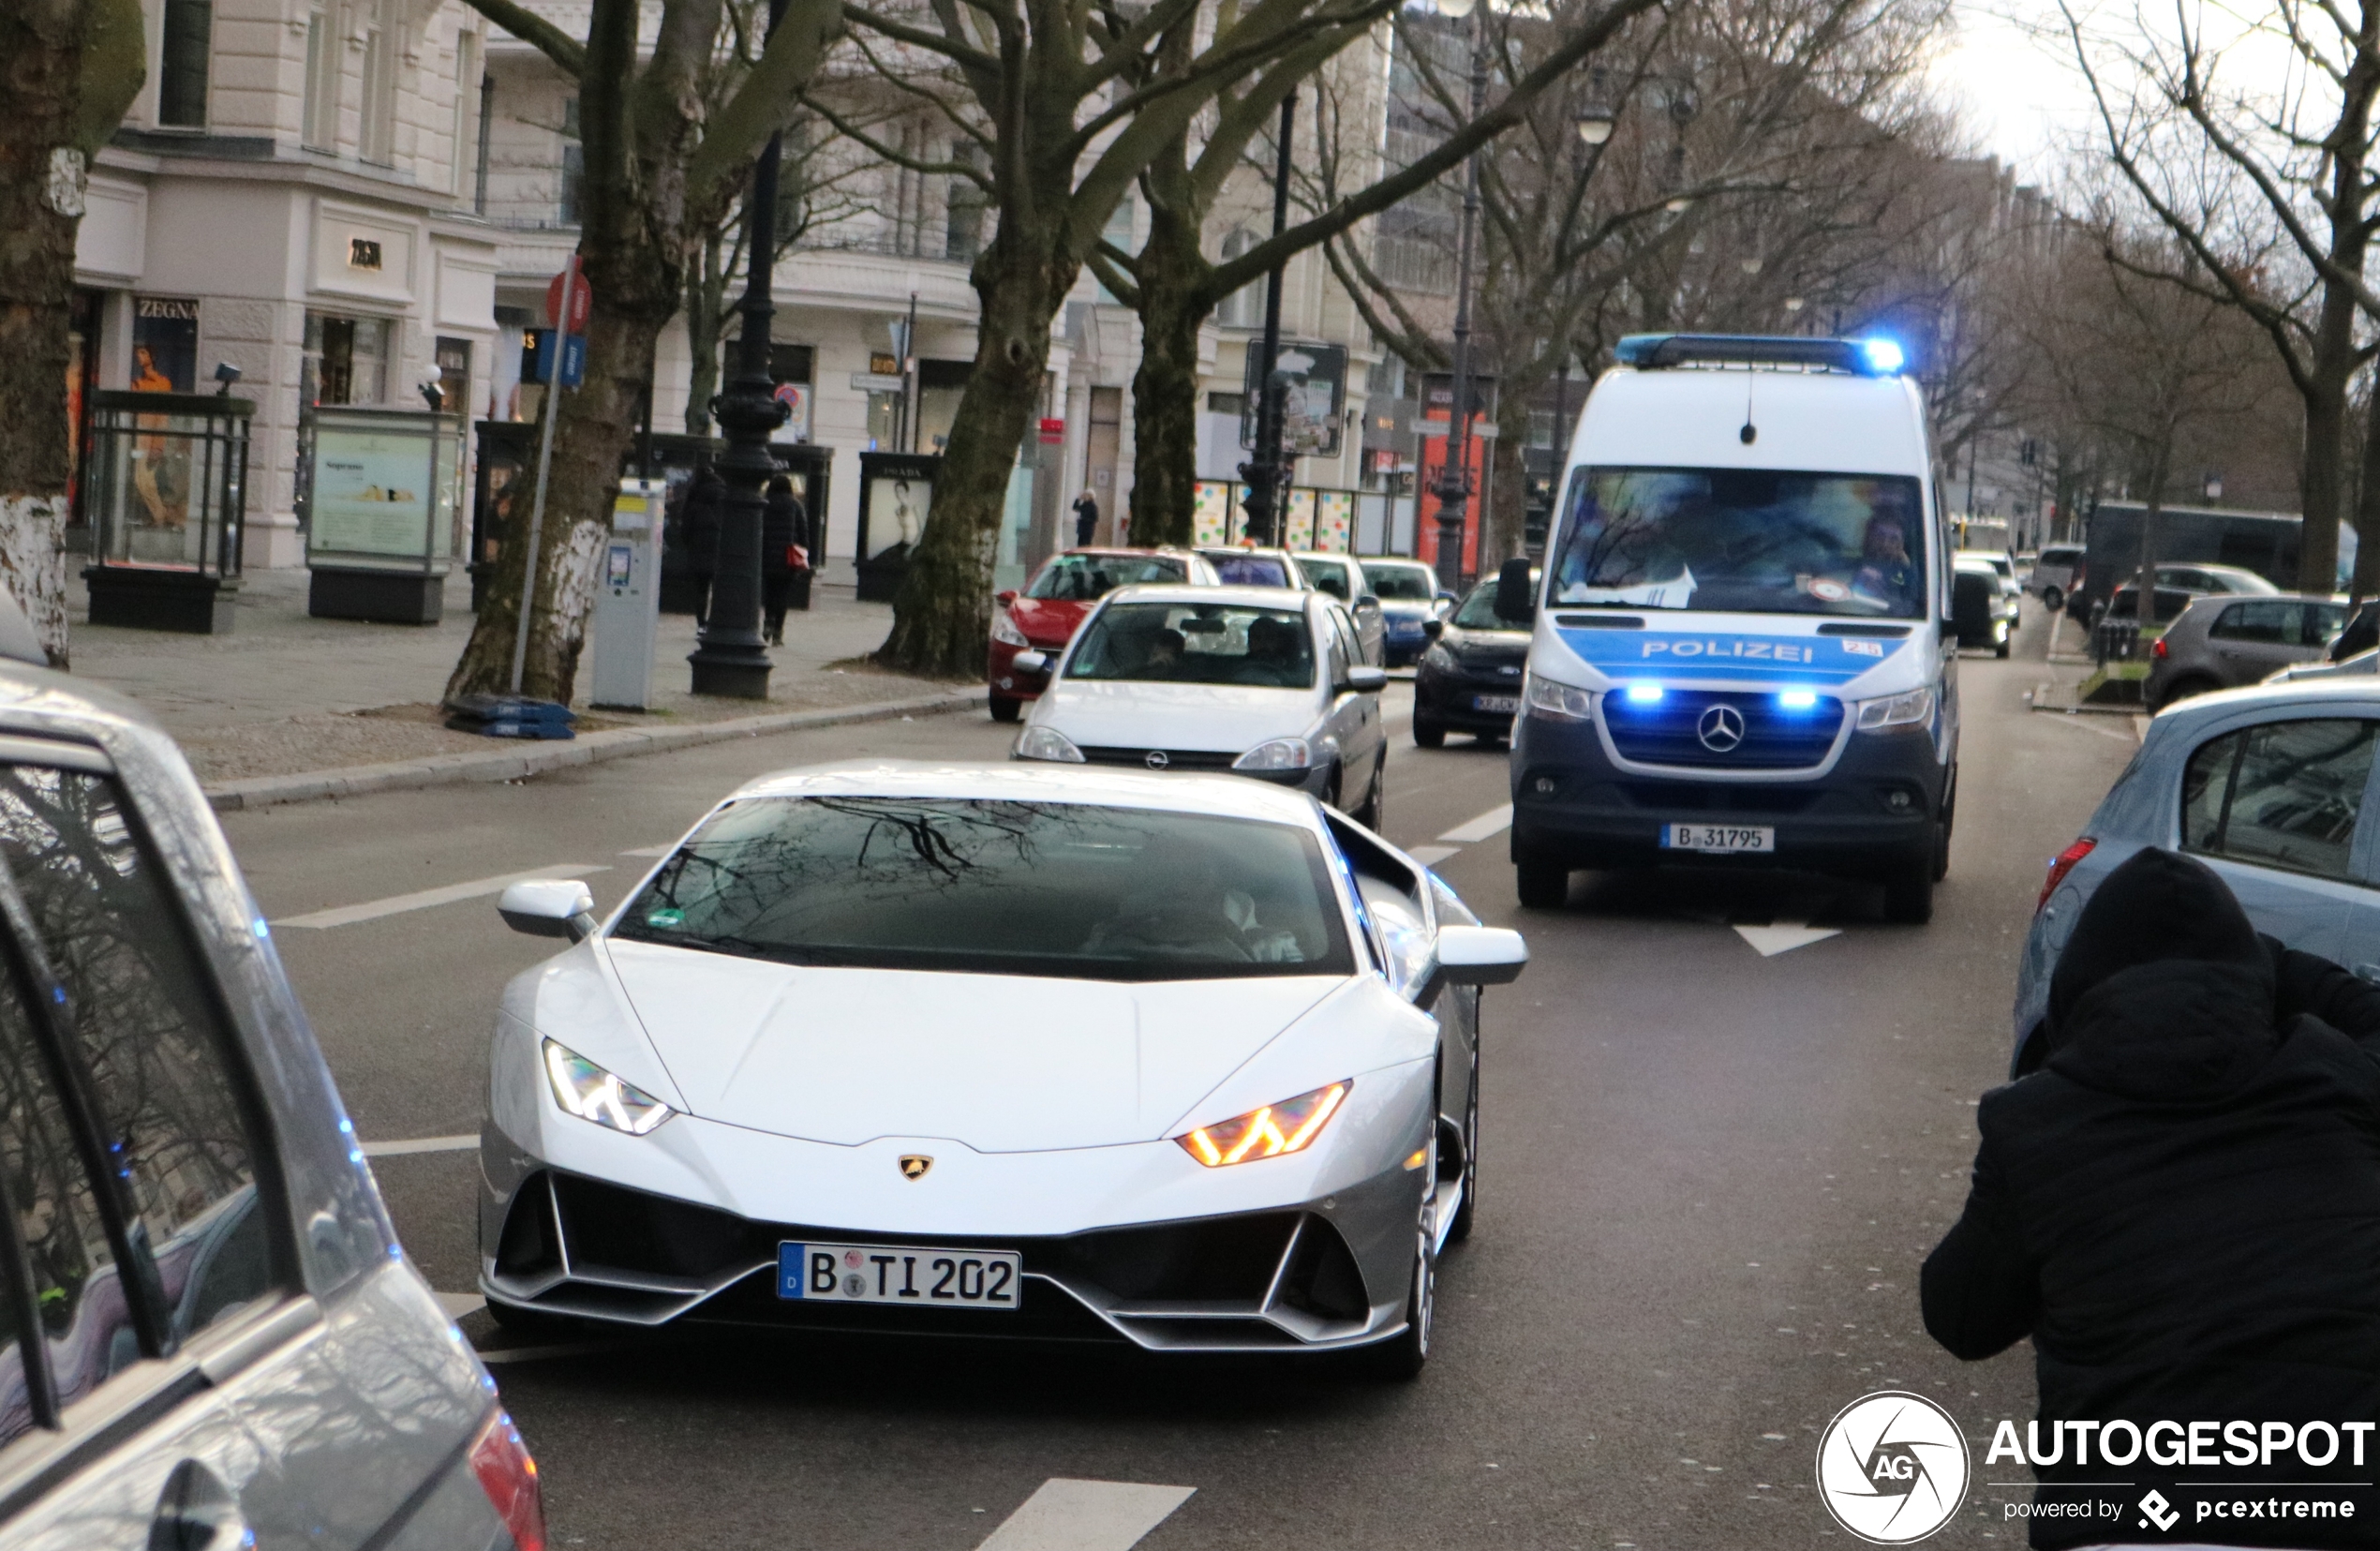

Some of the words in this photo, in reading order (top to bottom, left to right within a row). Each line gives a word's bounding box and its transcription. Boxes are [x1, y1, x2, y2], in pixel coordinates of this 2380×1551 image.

[140, 300, 199, 320] ZEGNA
[1642, 640, 1813, 664] POLIZEI
[1848, 642, 1879, 655] 25
[1679, 828, 1690, 845] B
[1703, 828, 1762, 847] 31795
[786, 1275, 796, 1290] D
[811, 1252, 838, 1293] B
[870, 1255, 920, 1297] TI
[930, 1258, 1013, 1302] 202
